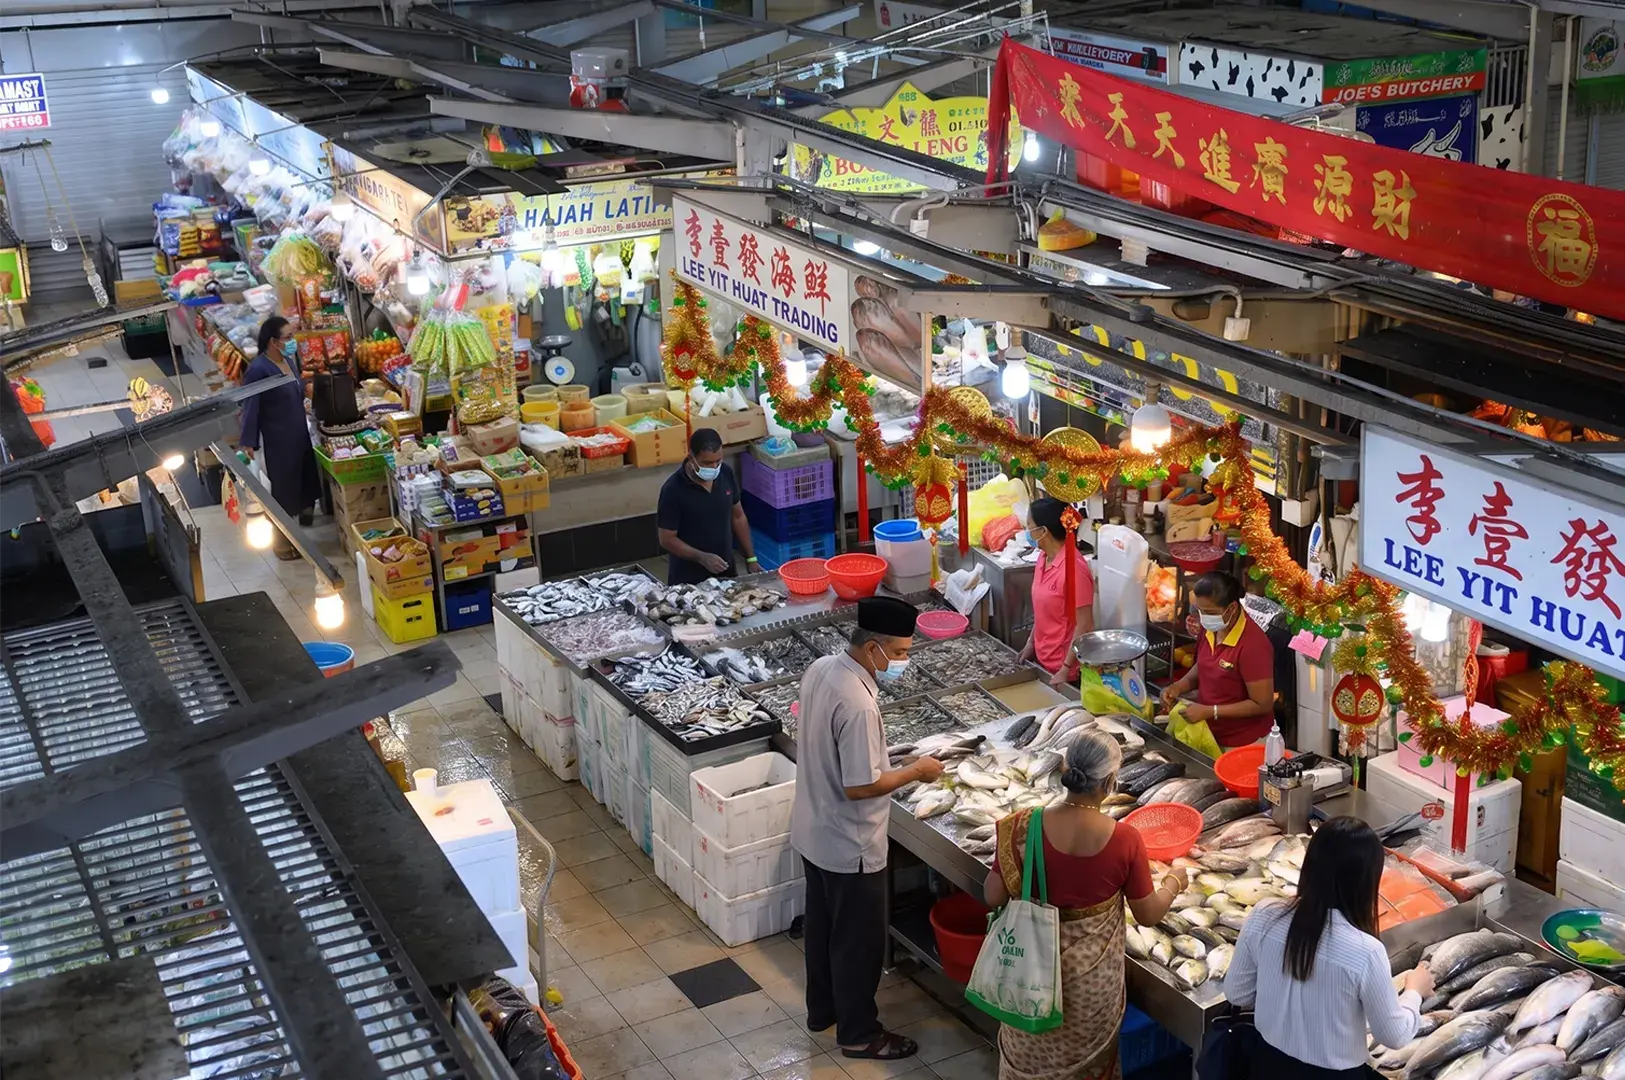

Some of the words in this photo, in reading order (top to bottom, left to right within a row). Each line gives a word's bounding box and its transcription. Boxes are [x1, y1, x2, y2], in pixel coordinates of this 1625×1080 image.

[1333, 86, 1381, 102] JOE'S
[1386, 75, 1475, 96] BUTCHERY
[524, 202, 594, 229] HAJAH
[1536, 207, 1592, 278] 福
[682, 256, 706, 282] LEE
[707, 267, 729, 293] YIT
[732, 278, 769, 312] HUAT
[771, 296, 839, 344] TRADING
[684, 208, 832, 319] 李壹發海鮮
[1384, 537, 1446, 588] LEE
[1456, 566, 1519, 616] YIT
[1395, 454, 1625, 620] 李壹發
